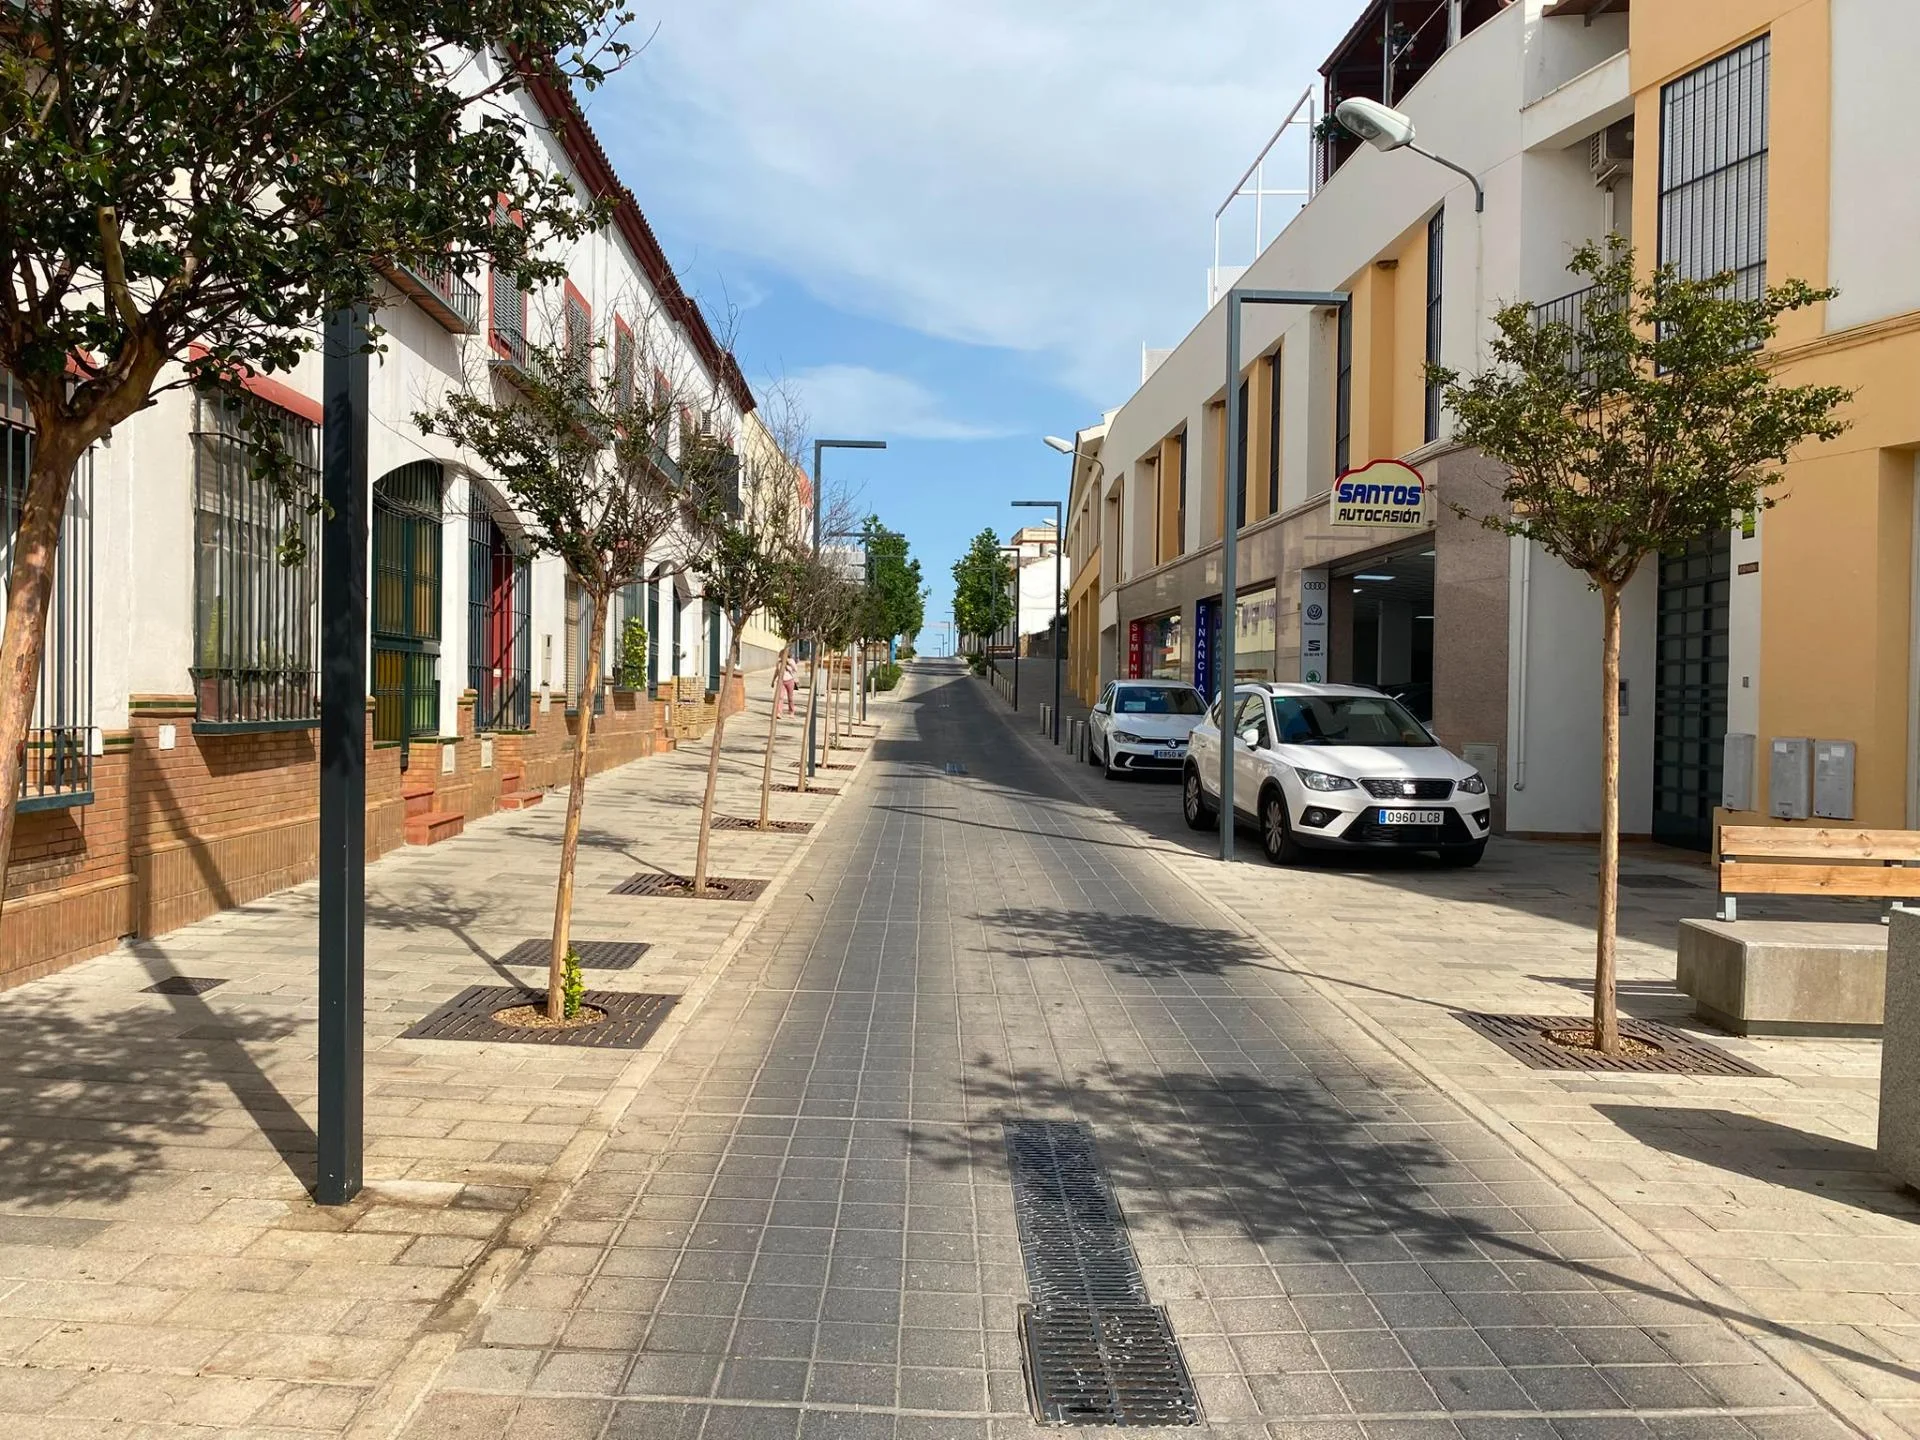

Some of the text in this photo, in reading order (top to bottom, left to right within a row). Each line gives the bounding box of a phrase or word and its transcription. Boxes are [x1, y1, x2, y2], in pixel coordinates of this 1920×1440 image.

[1338, 483, 1422, 505] SANTOS
[1338, 508, 1421, 523] AUTOCASIÓN
[1387, 812, 1441, 823] 0960 LCB
